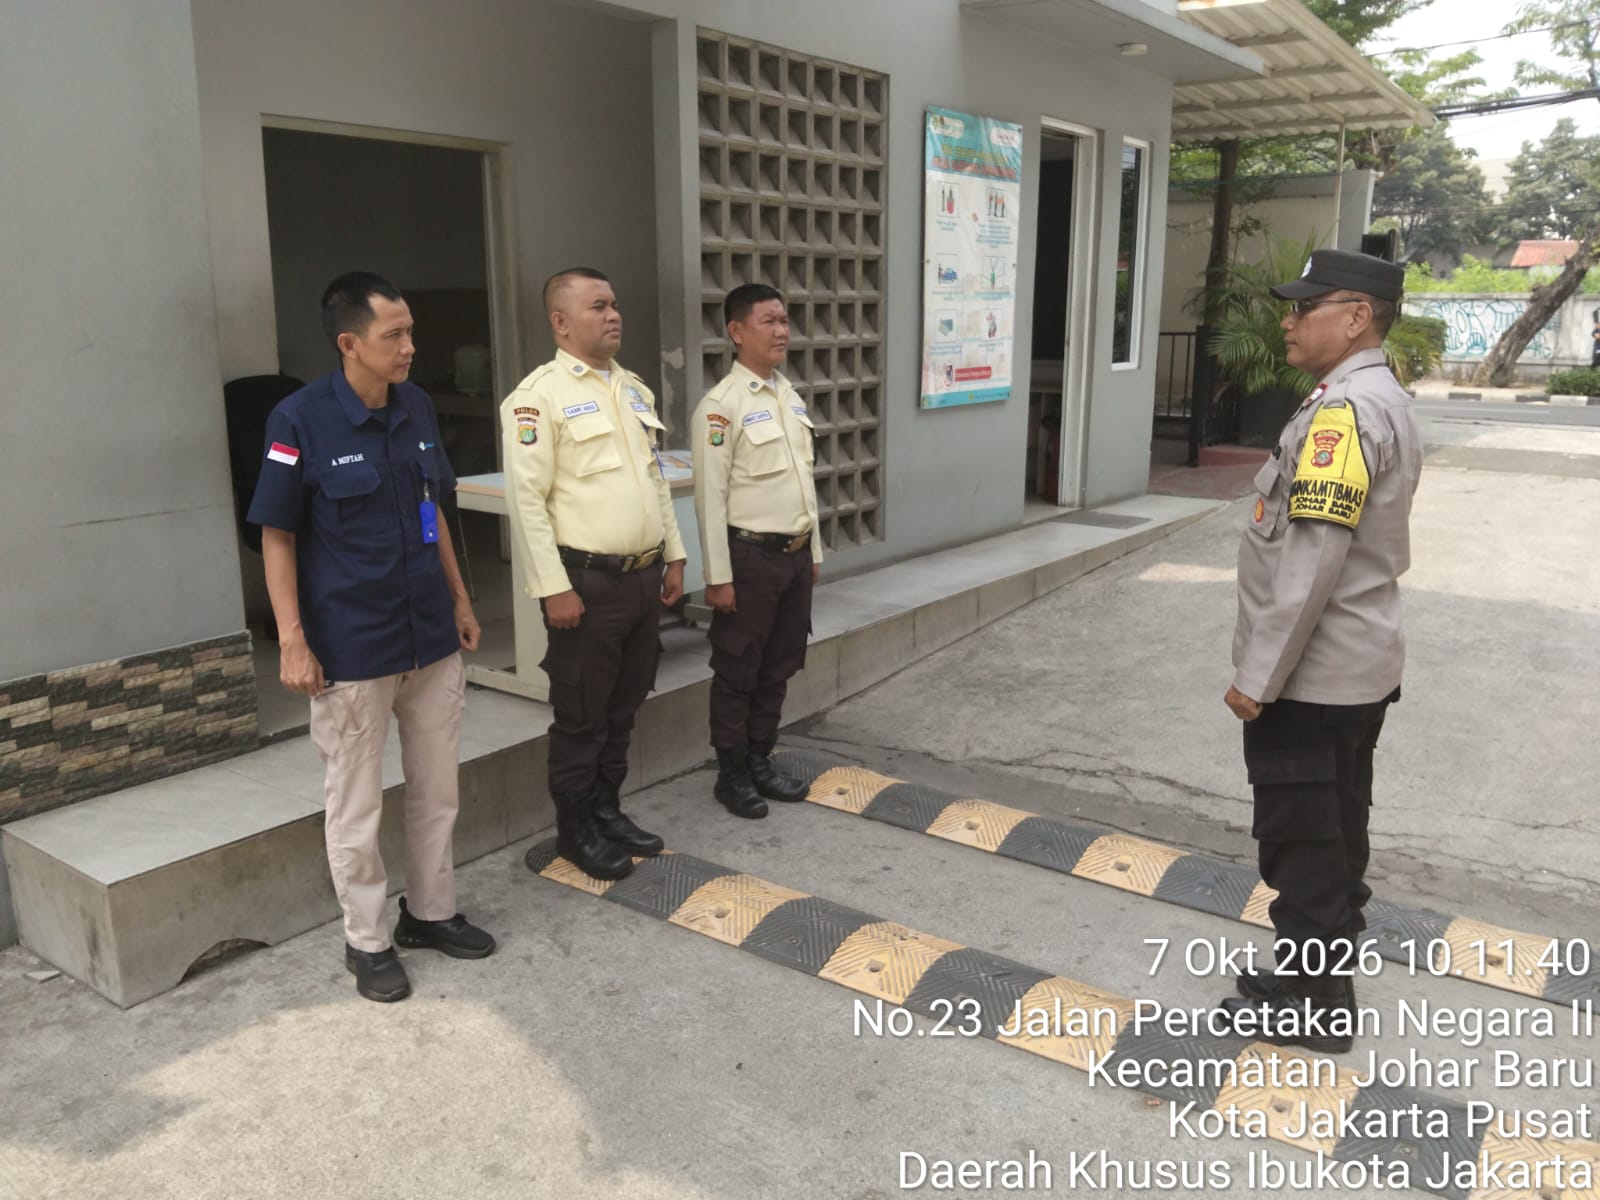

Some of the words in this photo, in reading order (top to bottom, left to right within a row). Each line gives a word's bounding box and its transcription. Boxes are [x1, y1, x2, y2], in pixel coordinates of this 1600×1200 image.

[1295, 496, 1327, 505] JOHAR
[1331, 500, 1356, 513] BARU
[1295, 503, 1324, 512] JOHAR
[1328, 507, 1351, 519] BARU
